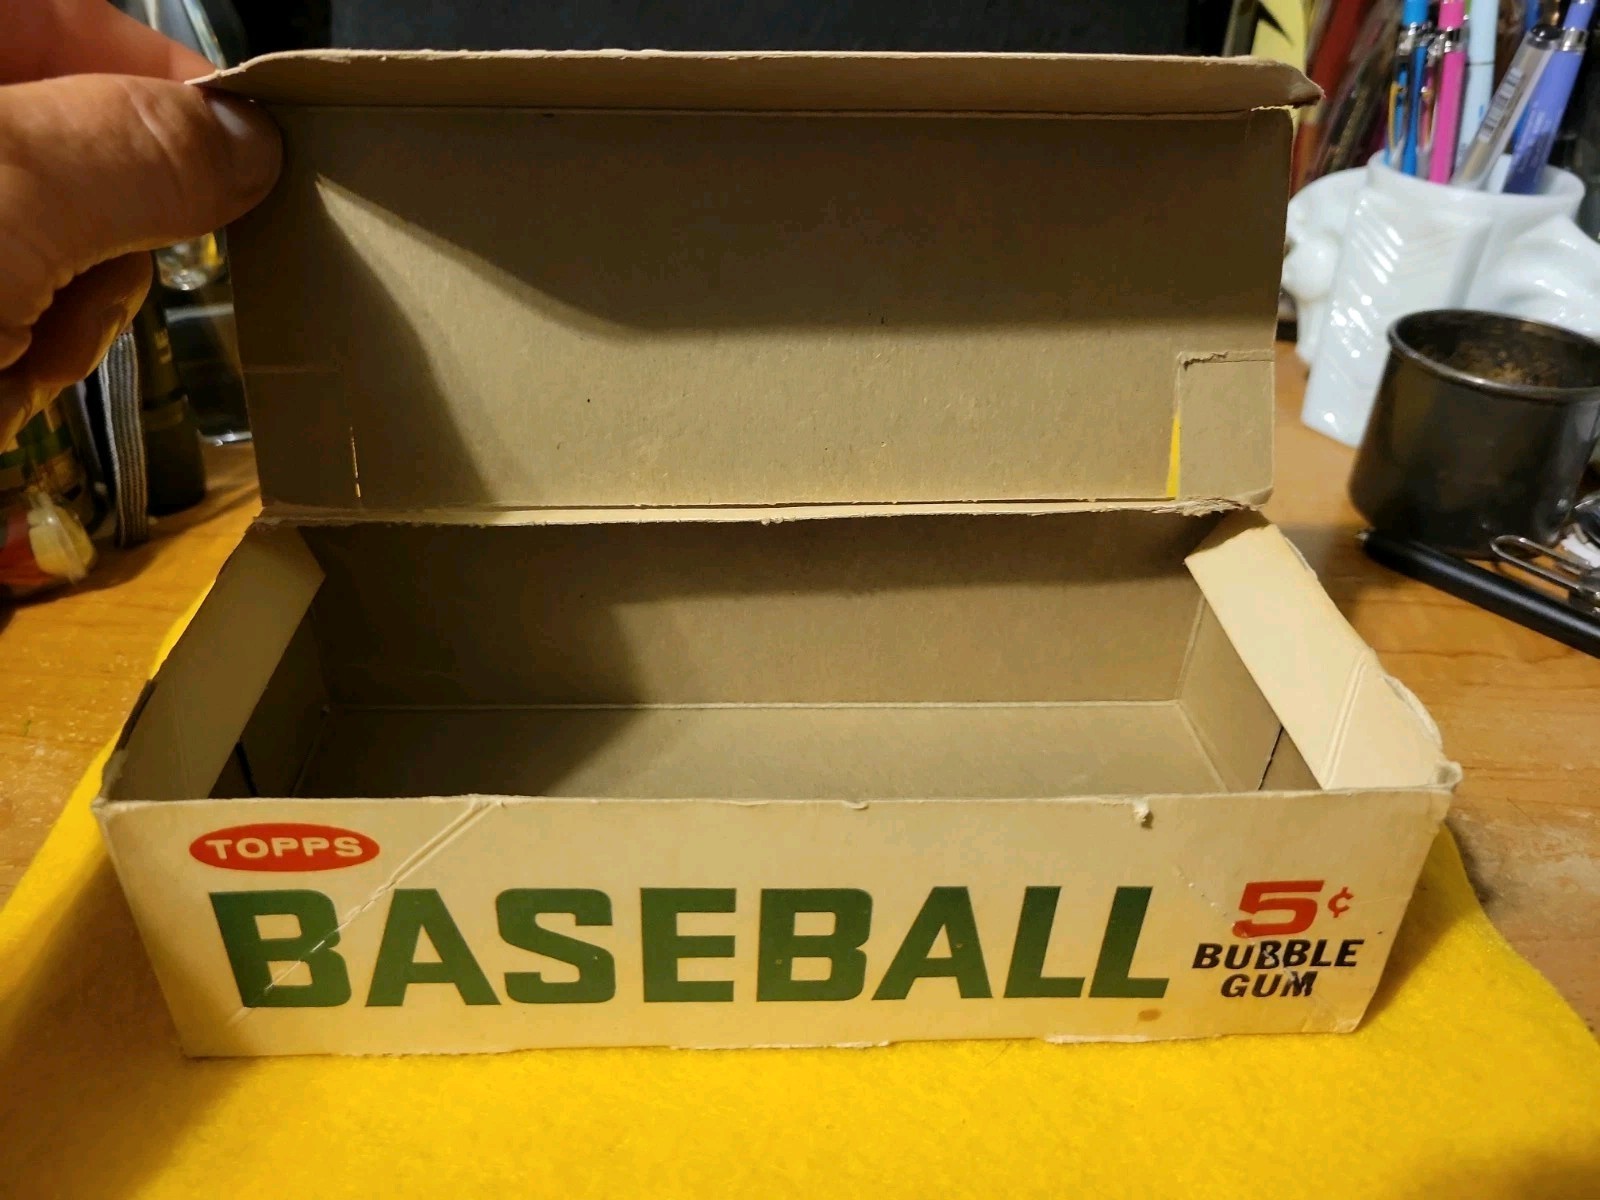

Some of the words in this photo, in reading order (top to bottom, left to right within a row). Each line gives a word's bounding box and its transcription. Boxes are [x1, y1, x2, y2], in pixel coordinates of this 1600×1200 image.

[205, 836, 364, 860] TOPPS
[208, 886, 1170, 1008] BASEBALL
[1192, 939, 1365, 969] BUBBLE
[1220, 971, 1318, 997] GUM
